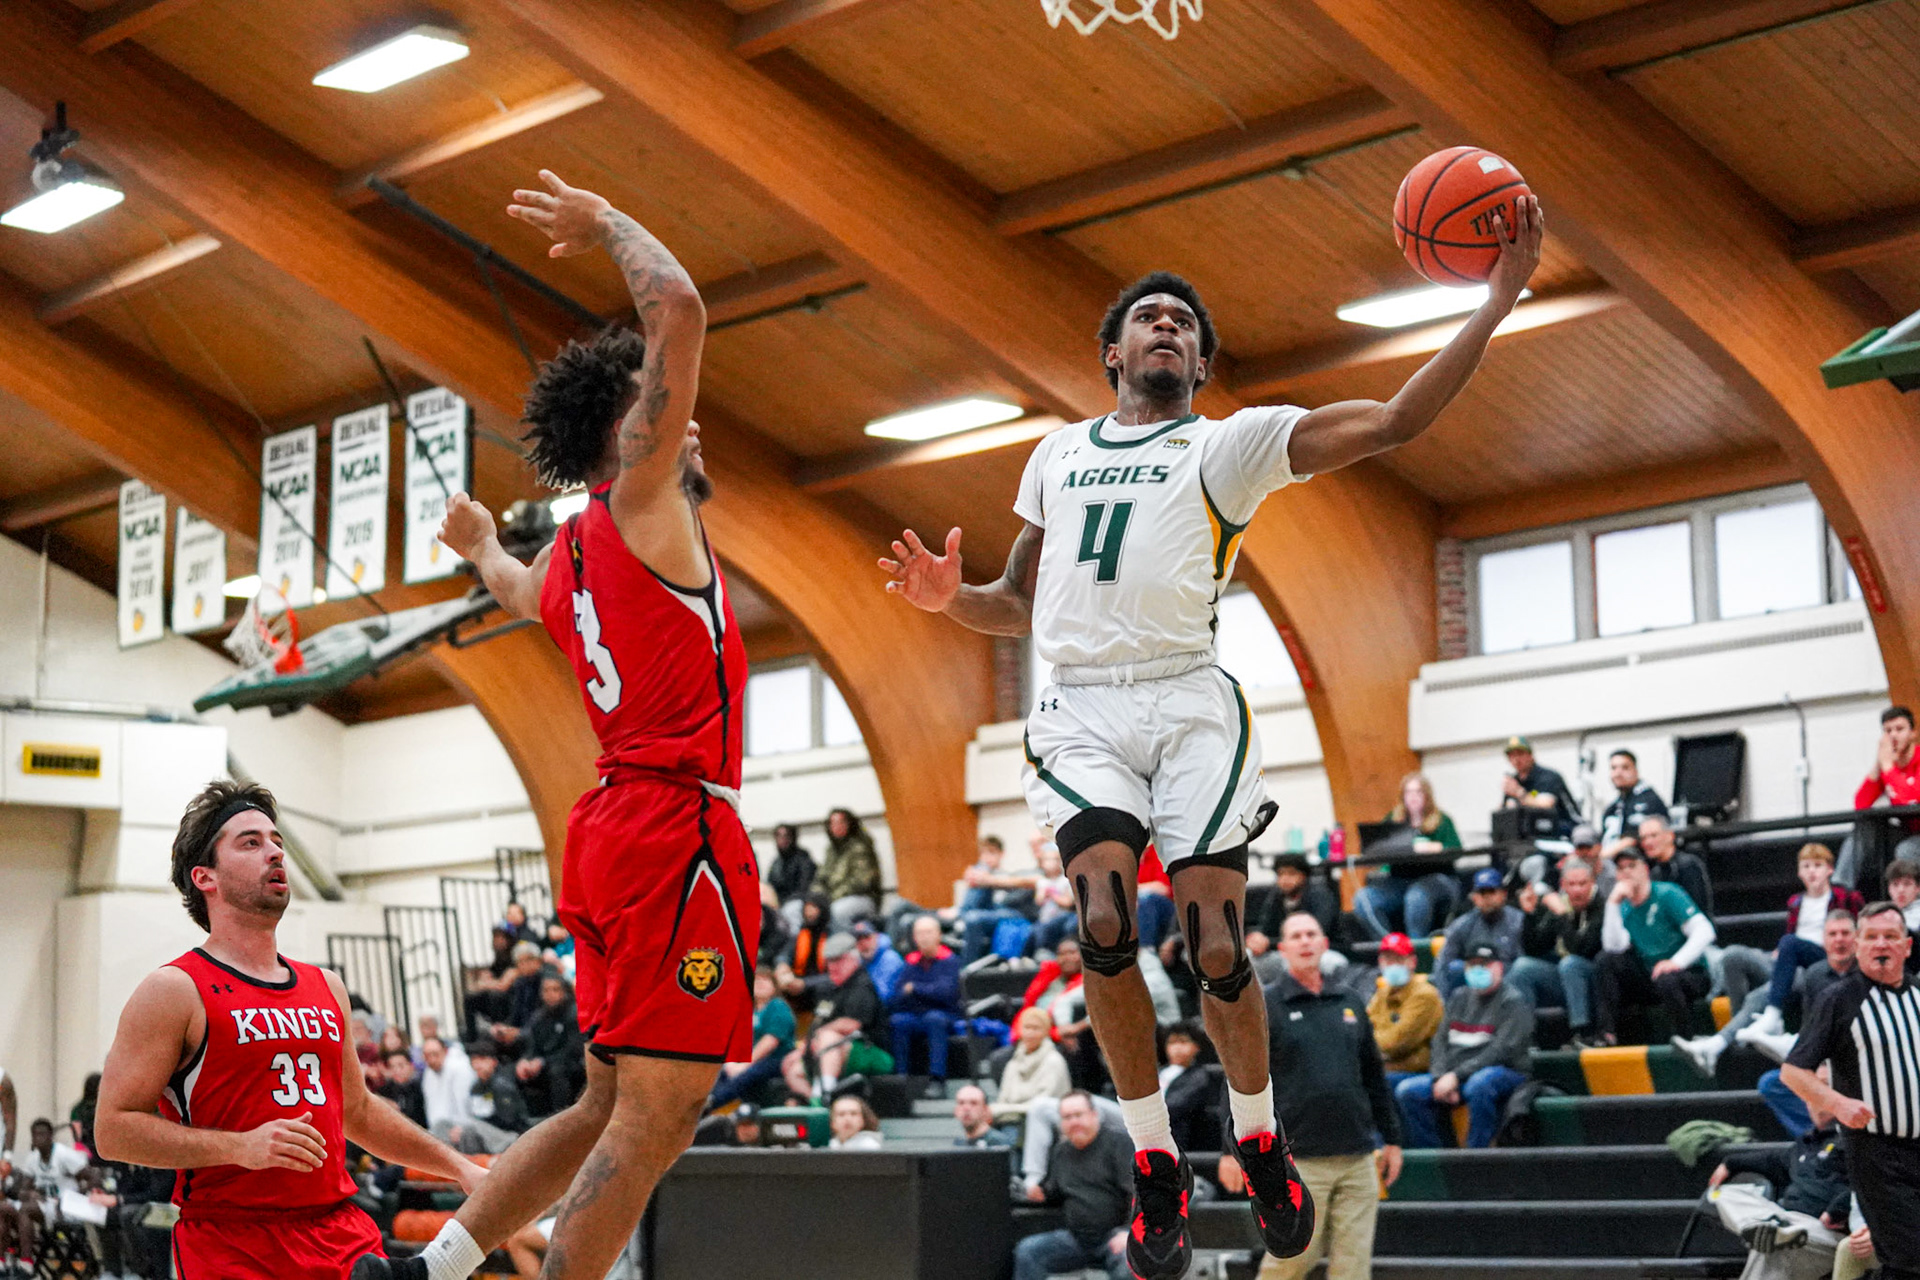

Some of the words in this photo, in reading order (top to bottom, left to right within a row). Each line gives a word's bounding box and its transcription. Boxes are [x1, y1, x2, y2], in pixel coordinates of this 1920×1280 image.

[340, 454, 381, 482] NCAA
[1061, 464, 1169, 491] AGGIES
[1076, 500, 1136, 584] 4
[572, 588, 622, 715] 3
[230, 1006, 340, 1045] KING'S
[270, 1053, 327, 1107] 33
